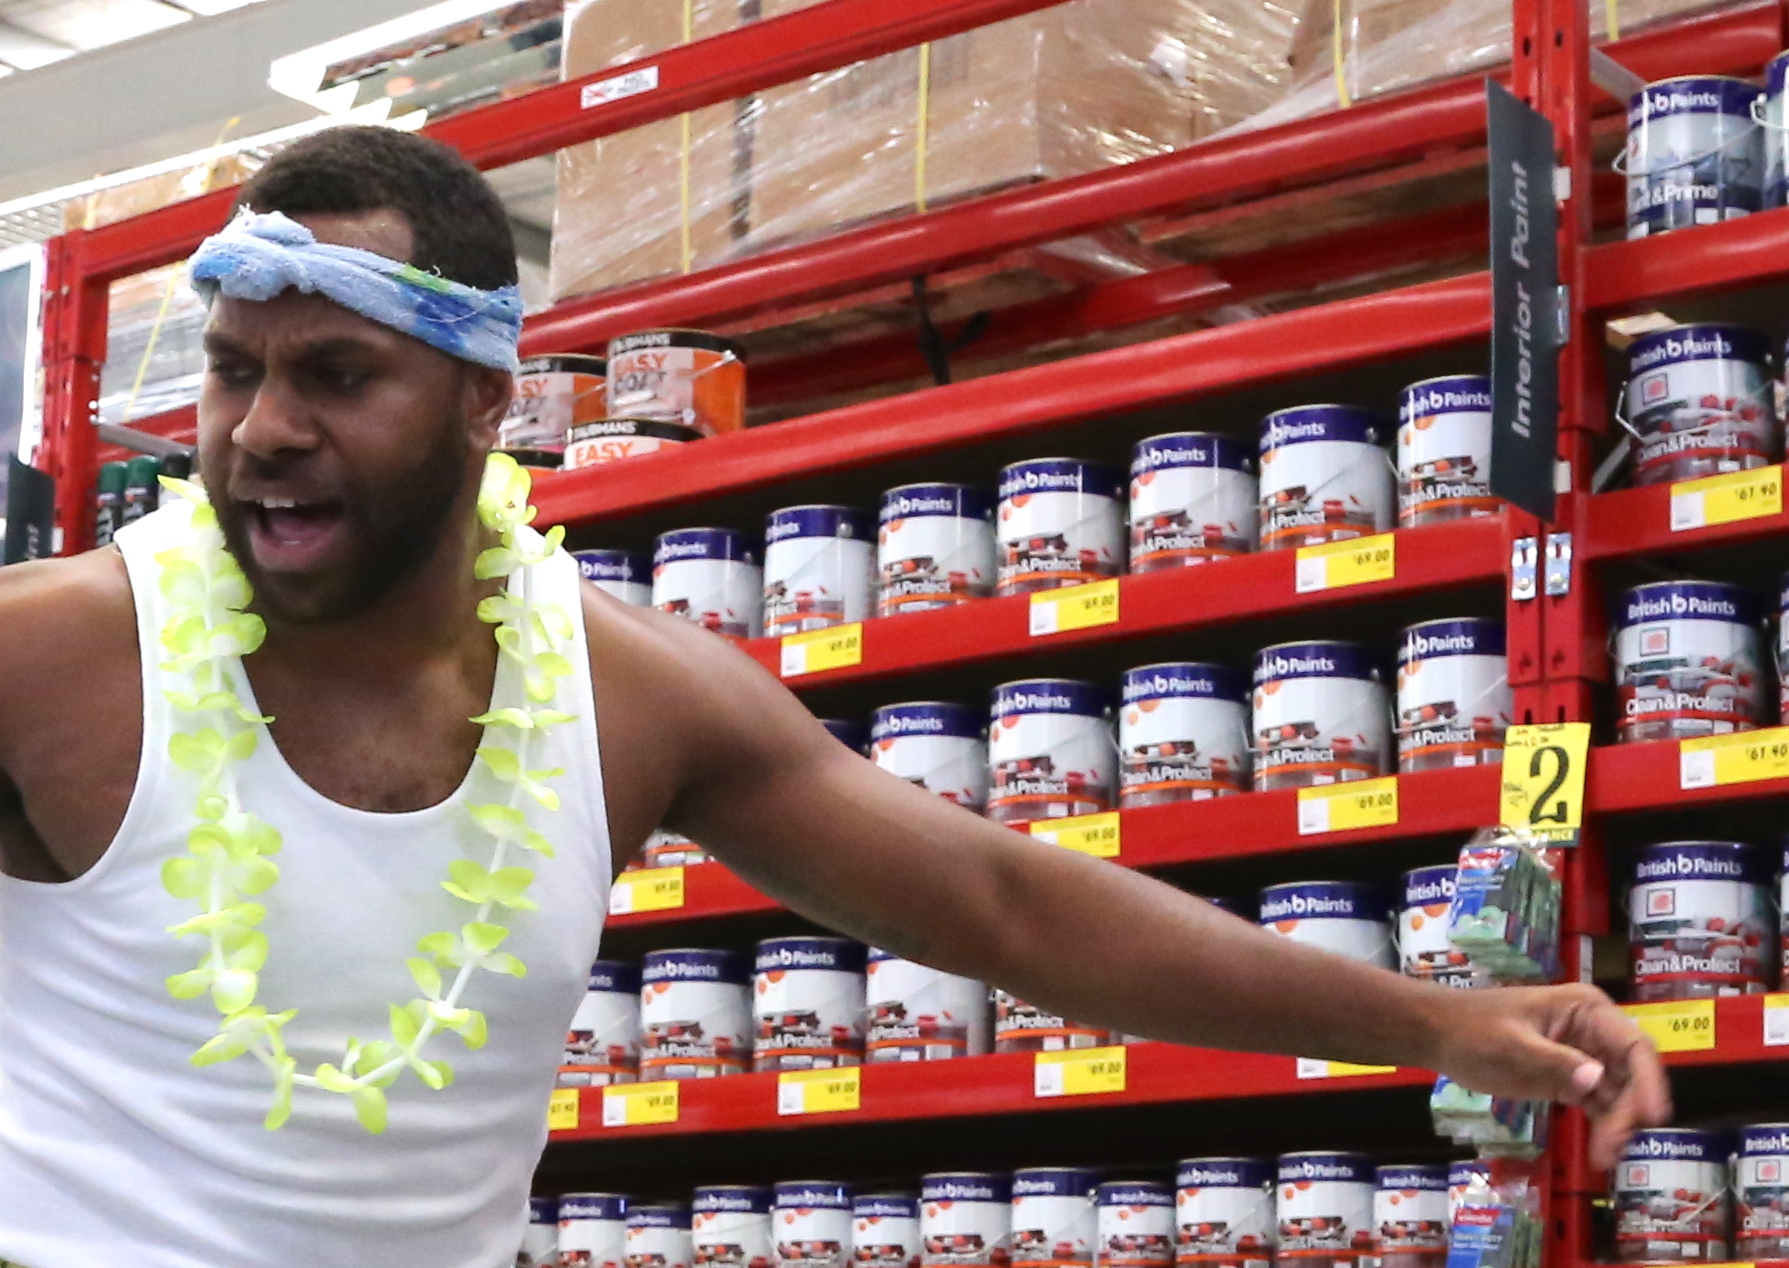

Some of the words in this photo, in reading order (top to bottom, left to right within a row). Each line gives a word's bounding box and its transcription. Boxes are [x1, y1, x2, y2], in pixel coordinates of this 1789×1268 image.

[1670, 92, 1720, 107] Paints
[1512, 161, 1529, 268] Paint
[1683, 335, 1731, 354] Paints
[616, 354, 667, 373] EASY
[1513, 282, 1531, 438] Interior
[1446, 393, 1490, 408] Paints
[1283, 423, 1325, 438] Paints
[576, 442, 630, 461] EASY
[1163, 448, 1206, 462] Paints
[1039, 474, 1082, 487] Paints
[912, 496, 952, 513] Paints
[1629, 598, 1671, 617] British
[1689, 596, 1735, 614] Paints
[1430, 634, 1474, 650] Paints
[1290, 658, 1334, 672] Paints
[1170, 676, 1213, 692] Paints
[1028, 693, 1070, 709] Paints
[902, 713, 942, 731] Paints
[1529, 745, 1569, 824] 2
[1637, 861, 1675, 878] British
[1694, 858, 1741, 875] Paints
[1306, 898, 1352, 913] Paints
[793, 950, 834, 964] Paints
[678, 963, 718, 978] Paints
[1663, 1143, 1703, 1156] Paints
[1203, 1171, 1238, 1184] Paints
[1316, 1166, 1352, 1178] Paints
